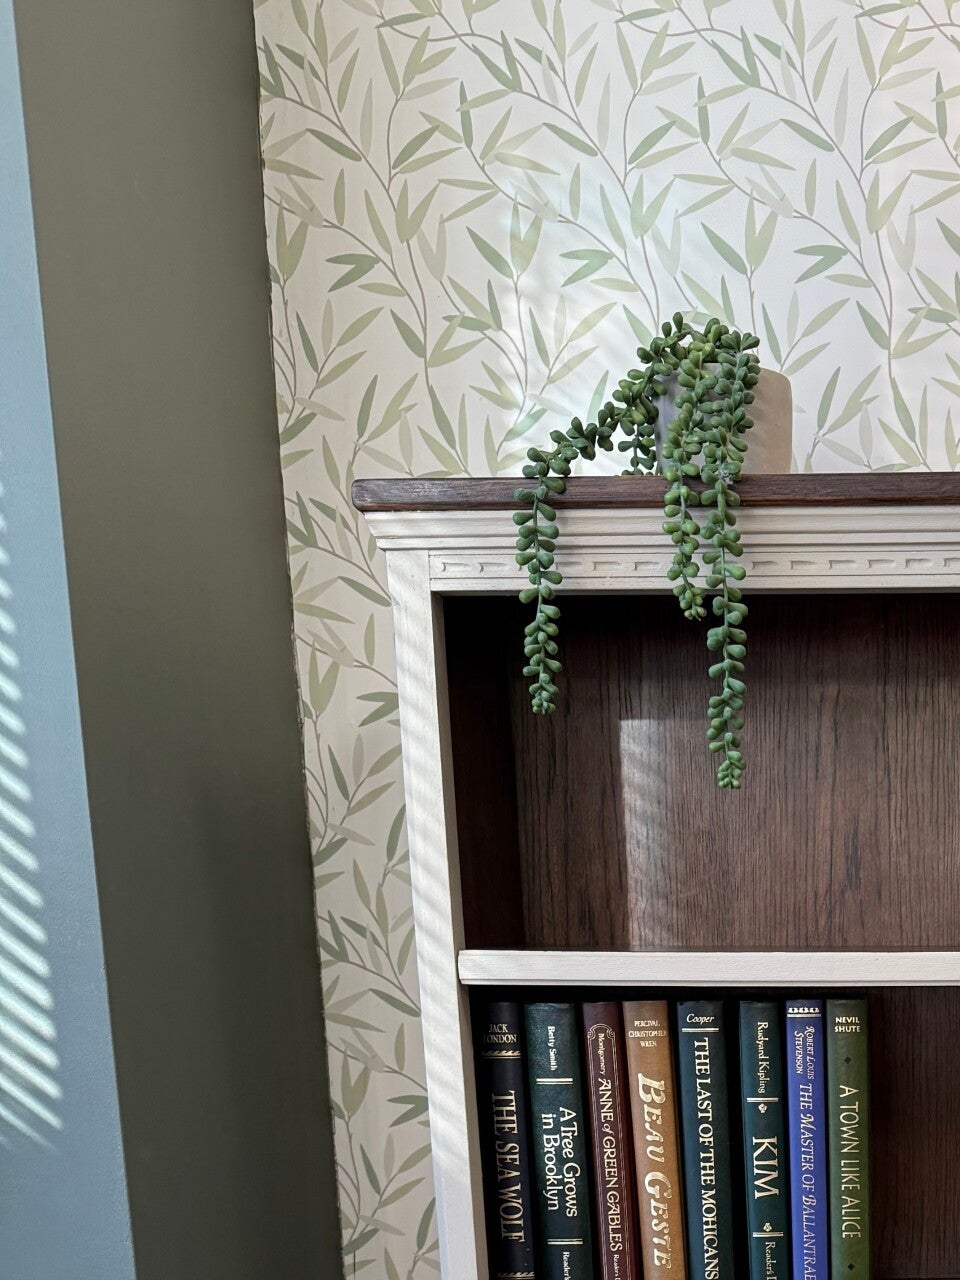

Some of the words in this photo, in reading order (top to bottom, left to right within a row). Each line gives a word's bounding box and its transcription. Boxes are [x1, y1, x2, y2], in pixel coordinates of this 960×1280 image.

[488, 1023, 509, 1033] JACK
[547, 1025, 556, 1048] Betty
[633, 1020, 661, 1028] PERCIVAL
[686, 1013, 715, 1026] Cooper
[834, 1025, 861, 1033] SHUTE
[835, 1016, 860, 1024] NEVIL
[597, 1033, 606, 1076] Montgomery
[640, 1040, 658, 1048] WREN
[694, 1037, 710, 1076] THE
[756, 1021, 770, 1059] Rudyard
[794, 1031, 804, 1075] STEVENSON
[804, 1026, 816, 1055] ROBERT
[549, 1048, 559, 1071] Smith
[757, 1061, 770, 1094] Kipling
[806, 1056, 816, 1080] LOUIS
[598, 1078, 614, 1123] ANNE
[696, 1077, 713, 1122] LAST
[799, 1083, 813, 1110] THE
[839, 1085, 859, 1098] A
[491, 1090, 518, 1136] THE
[541, 1113, 556, 1130] in
[559, 1106, 577, 1122] A
[602, 1123, 615, 1136] of
[637, 1072, 666, 1163] BEAU
[839, 1101, 860, 1153] TOWN
[560, 1121, 578, 1159] Tree
[698, 1123, 714, 1147] OF
[800, 1113, 816, 1171] MASTER
[495, 1140, 520, 1182] SEA
[542, 1134, 564, 1211] Brooklyn
[602, 1136, 619, 1188] GREEN
[700, 1148, 716, 1186] THE
[752, 1136, 780, 1200] KIM
[840, 1159, 860, 1191] LIKE
[563, 1162, 581, 1217] Grows
[801, 1174, 815, 1192] OF
[498, 1182, 526, 1243] WOLF
[606, 1191, 623, 1252] GABLES
[644, 1171, 673, 1269] GESTE
[841, 1195, 862, 1239] ALICE
[701, 1188, 719, 1280] MOHICANS
[764, 1241, 777, 1275] Reader's
